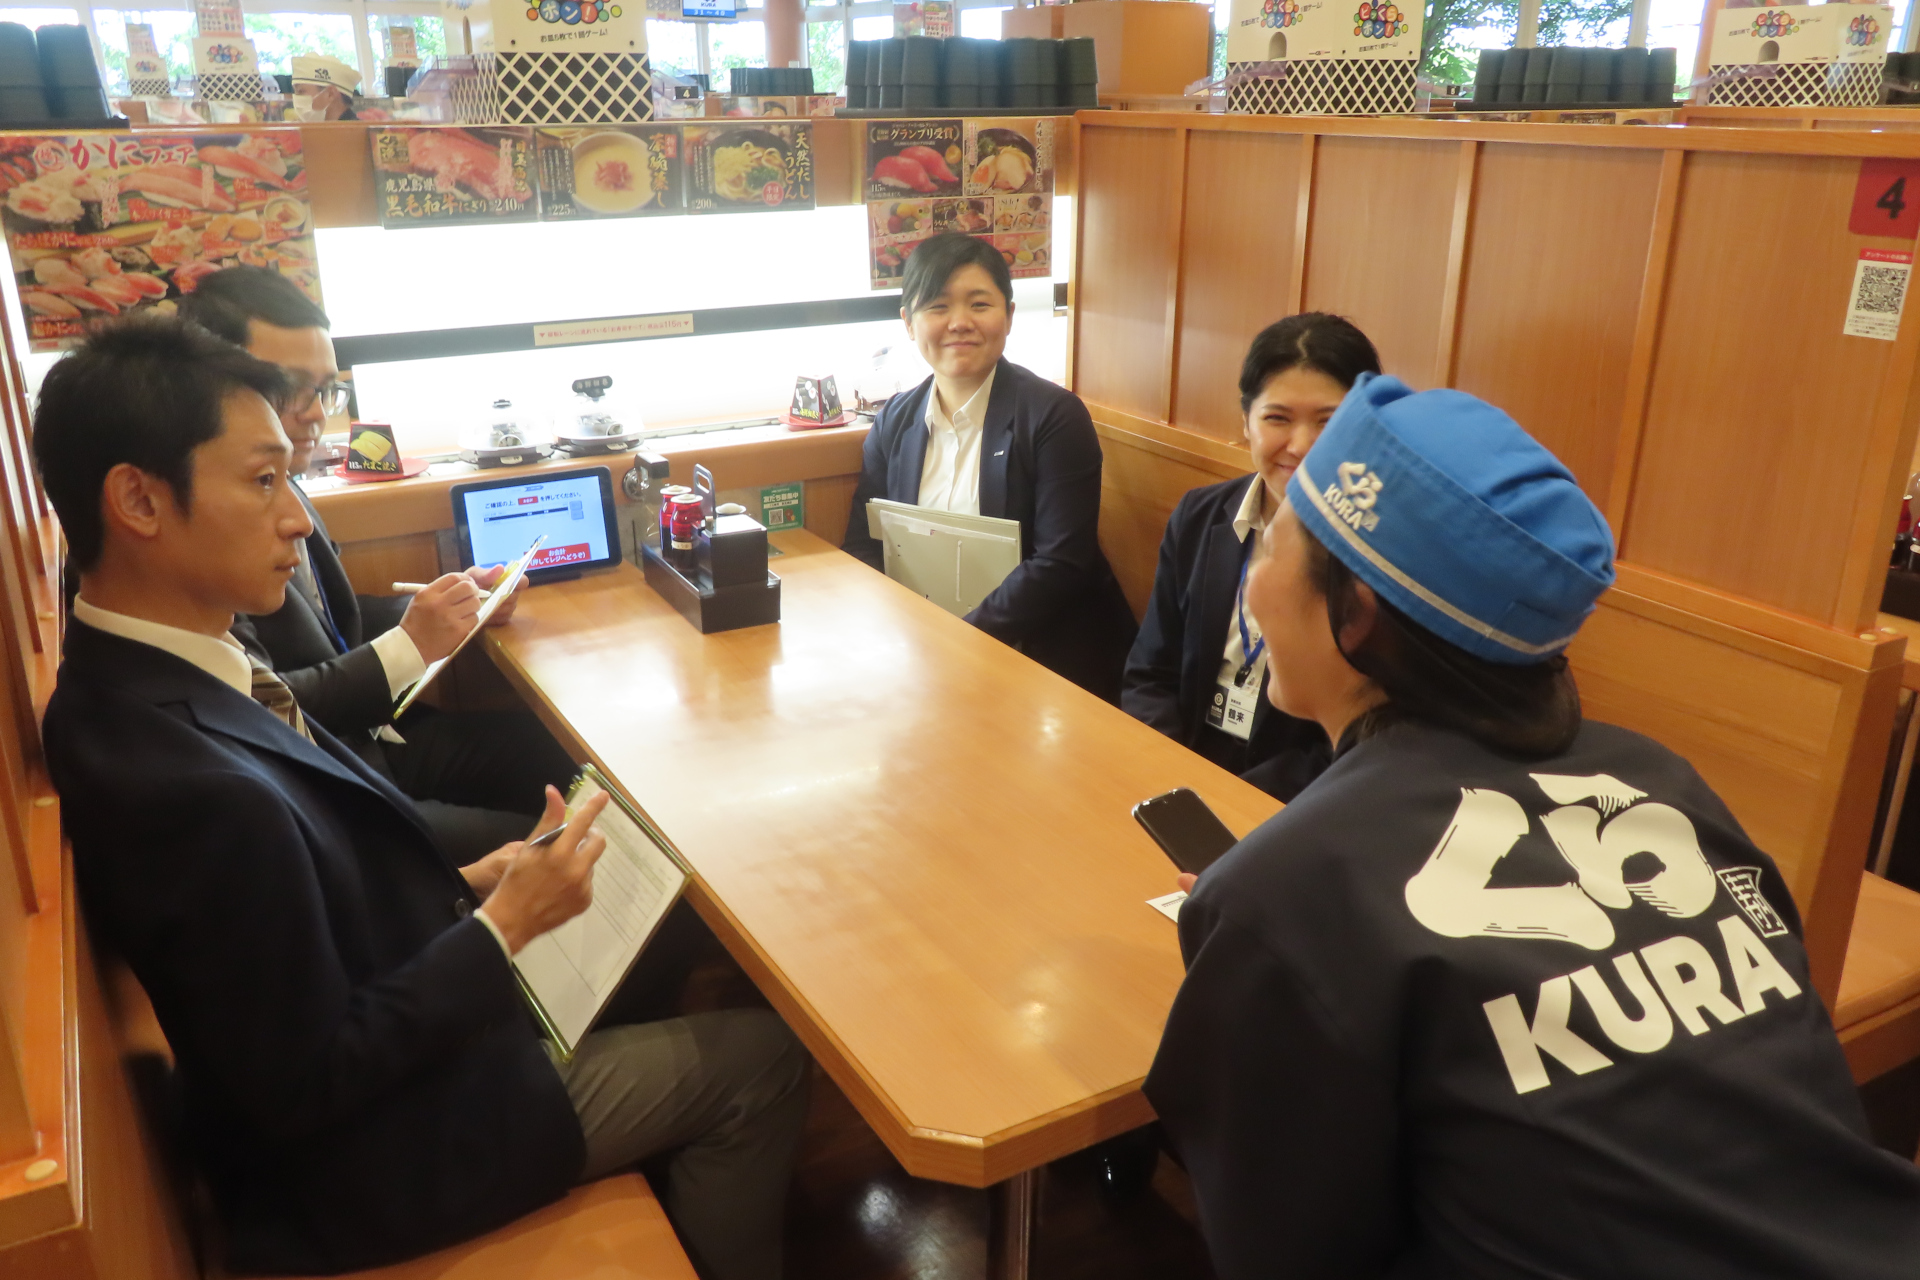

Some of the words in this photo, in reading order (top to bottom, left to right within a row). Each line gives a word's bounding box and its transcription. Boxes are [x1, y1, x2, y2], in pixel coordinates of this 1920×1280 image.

[69, 137, 195, 171] かにフェア
[890, 127, 954, 140] グランプリ受賞
[784, 151, 797, 200] うどん
[1876, 177, 1907, 220] 4
[1323, 483, 1363, 531] KURA
[1482, 914, 1802, 1096] KURA
